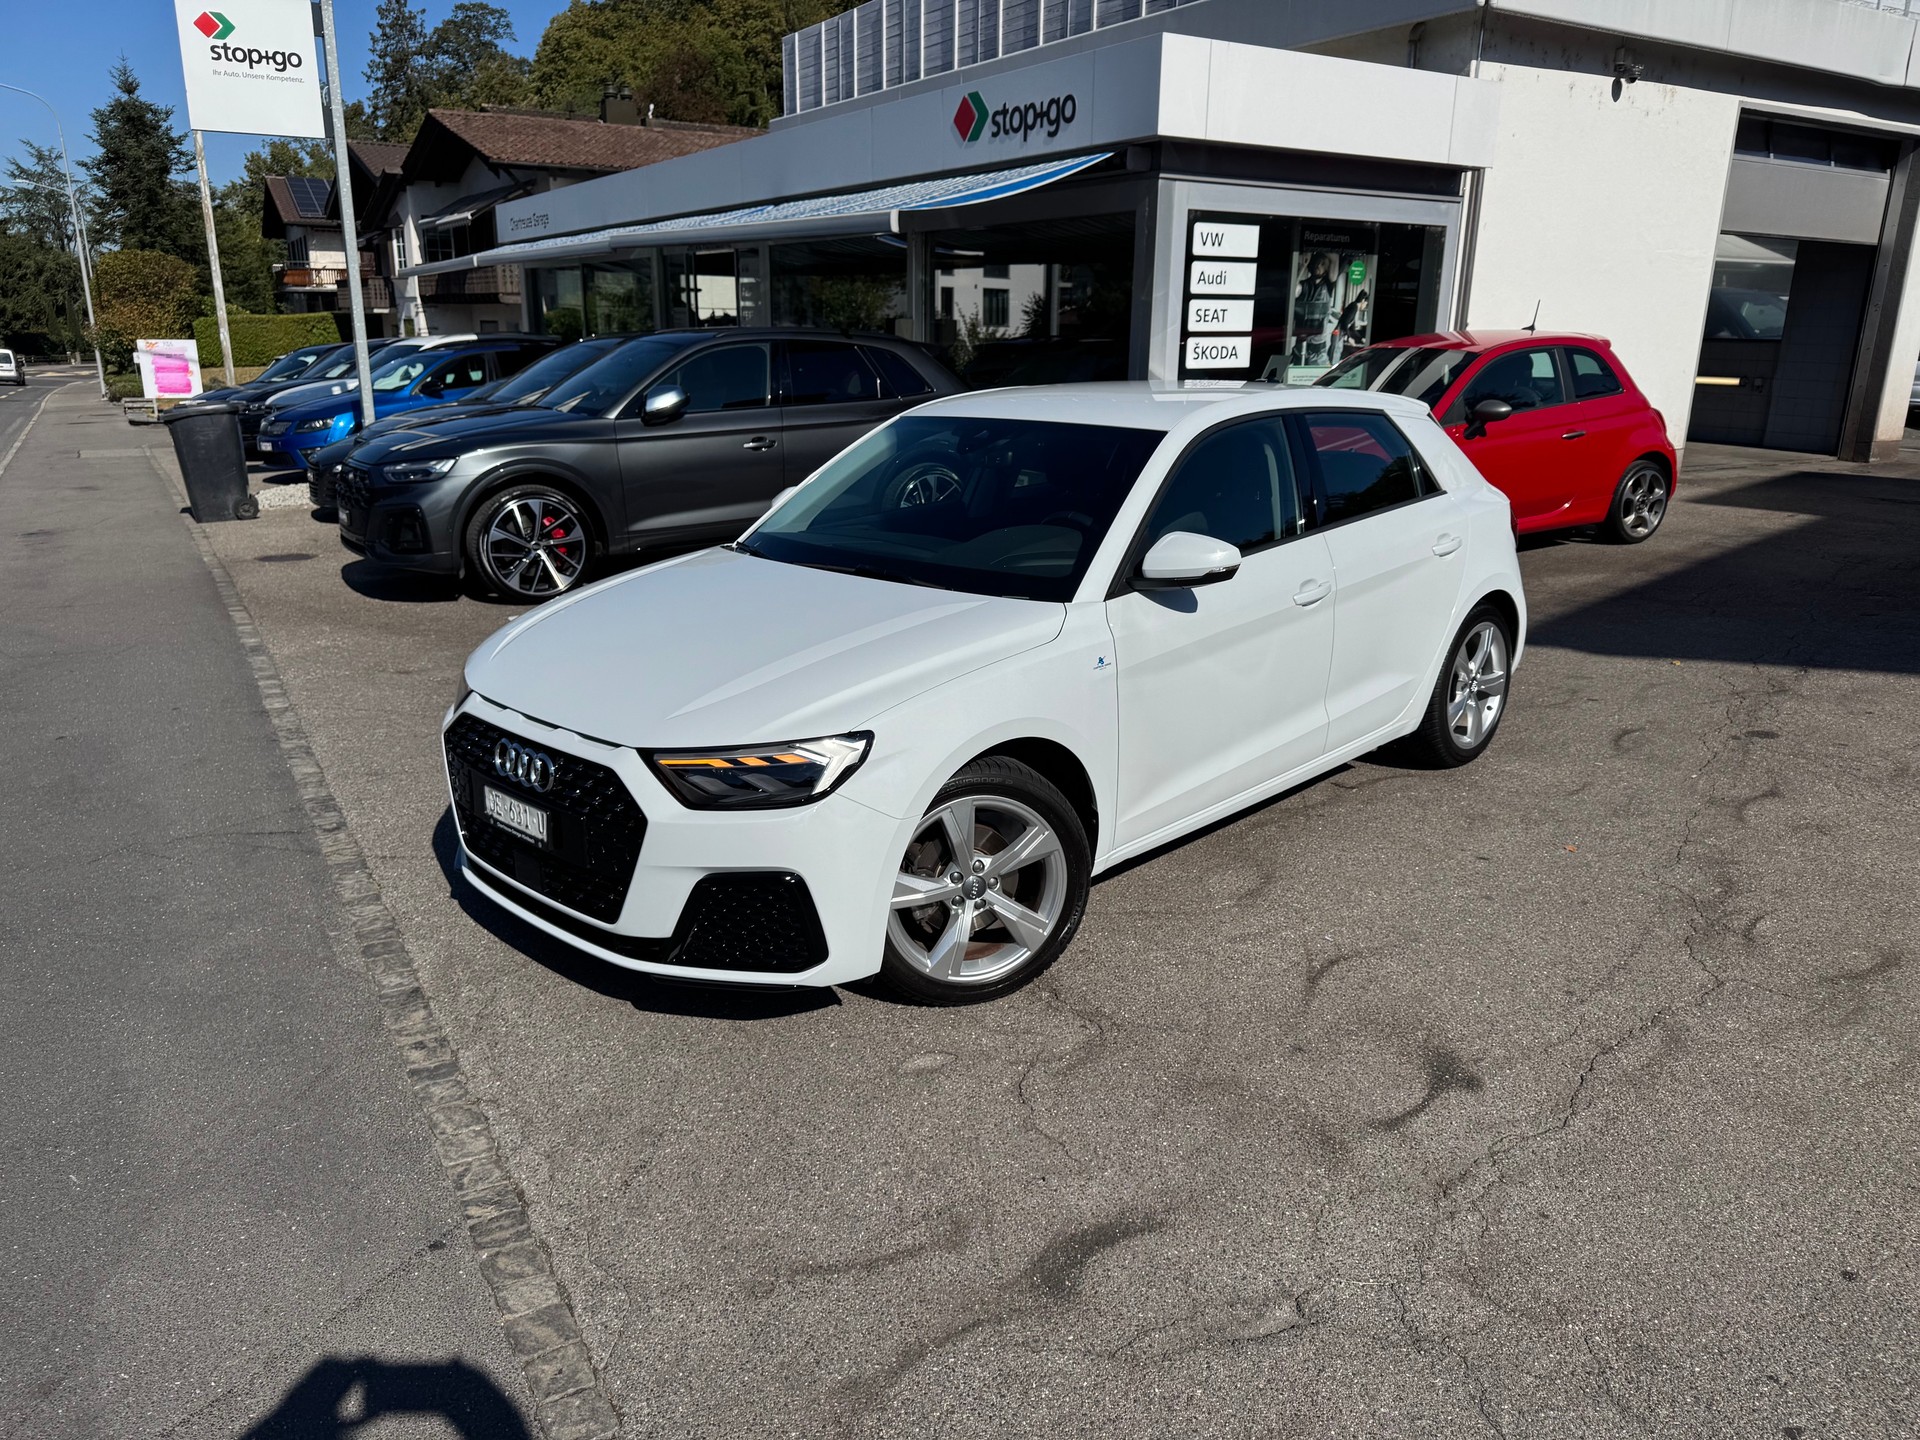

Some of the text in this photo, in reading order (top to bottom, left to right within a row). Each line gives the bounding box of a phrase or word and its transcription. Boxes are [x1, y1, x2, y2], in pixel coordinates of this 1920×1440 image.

[210, 42, 303, 72] stop+go
[223, 69, 241, 78] Auto.
[242, 71, 265, 80] Unsere
[266, 73, 305, 84] Kompetenz.
[991, 94, 1077, 142] stop+go
[1200, 231, 1225, 247] VW
[1304, 230, 1350, 243] Reparaturen
[1197, 270, 1227, 286] Audi
[1195, 308, 1228, 323] SEAT
[1192, 342, 1239, 360] ŠKODA
